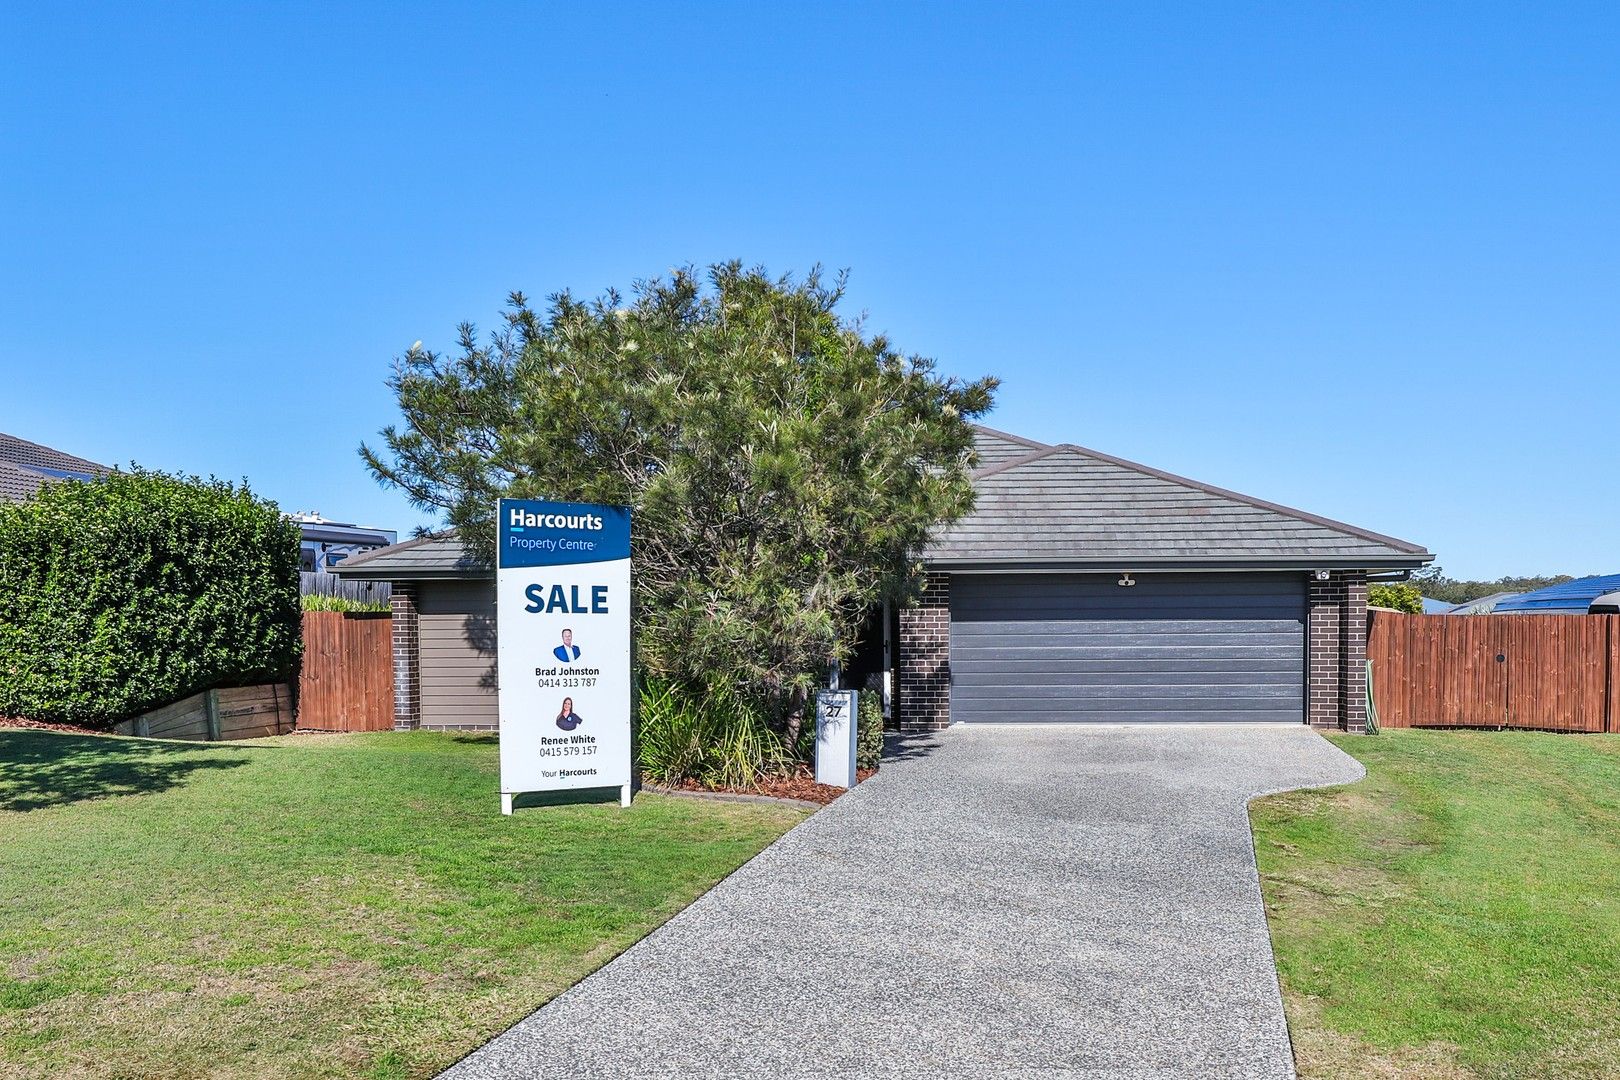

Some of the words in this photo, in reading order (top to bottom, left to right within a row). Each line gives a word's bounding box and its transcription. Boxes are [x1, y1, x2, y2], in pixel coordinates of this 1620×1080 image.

[510, 508, 603, 530] Harcourts
[510, 536, 557, 552] Property
[558, 538, 594, 550] Centre
[524, 583, 609, 614] SALE
[535, 667, 557, 676] Brad
[558, 667, 600, 676] Johnston
[538, 679, 561, 688] 0414
[562, 678, 579, 687] 313
[581, 678, 597, 687] 787
[825, 706, 842, 717] 27
[541, 736, 569, 745] Renee
[570, 734, 596, 744] White
[539, 747, 562, 757] 0415
[563, 747, 580, 756] 579
[582, 745, 598, 755] 157
[559, 768, 597, 776] Harcourts
